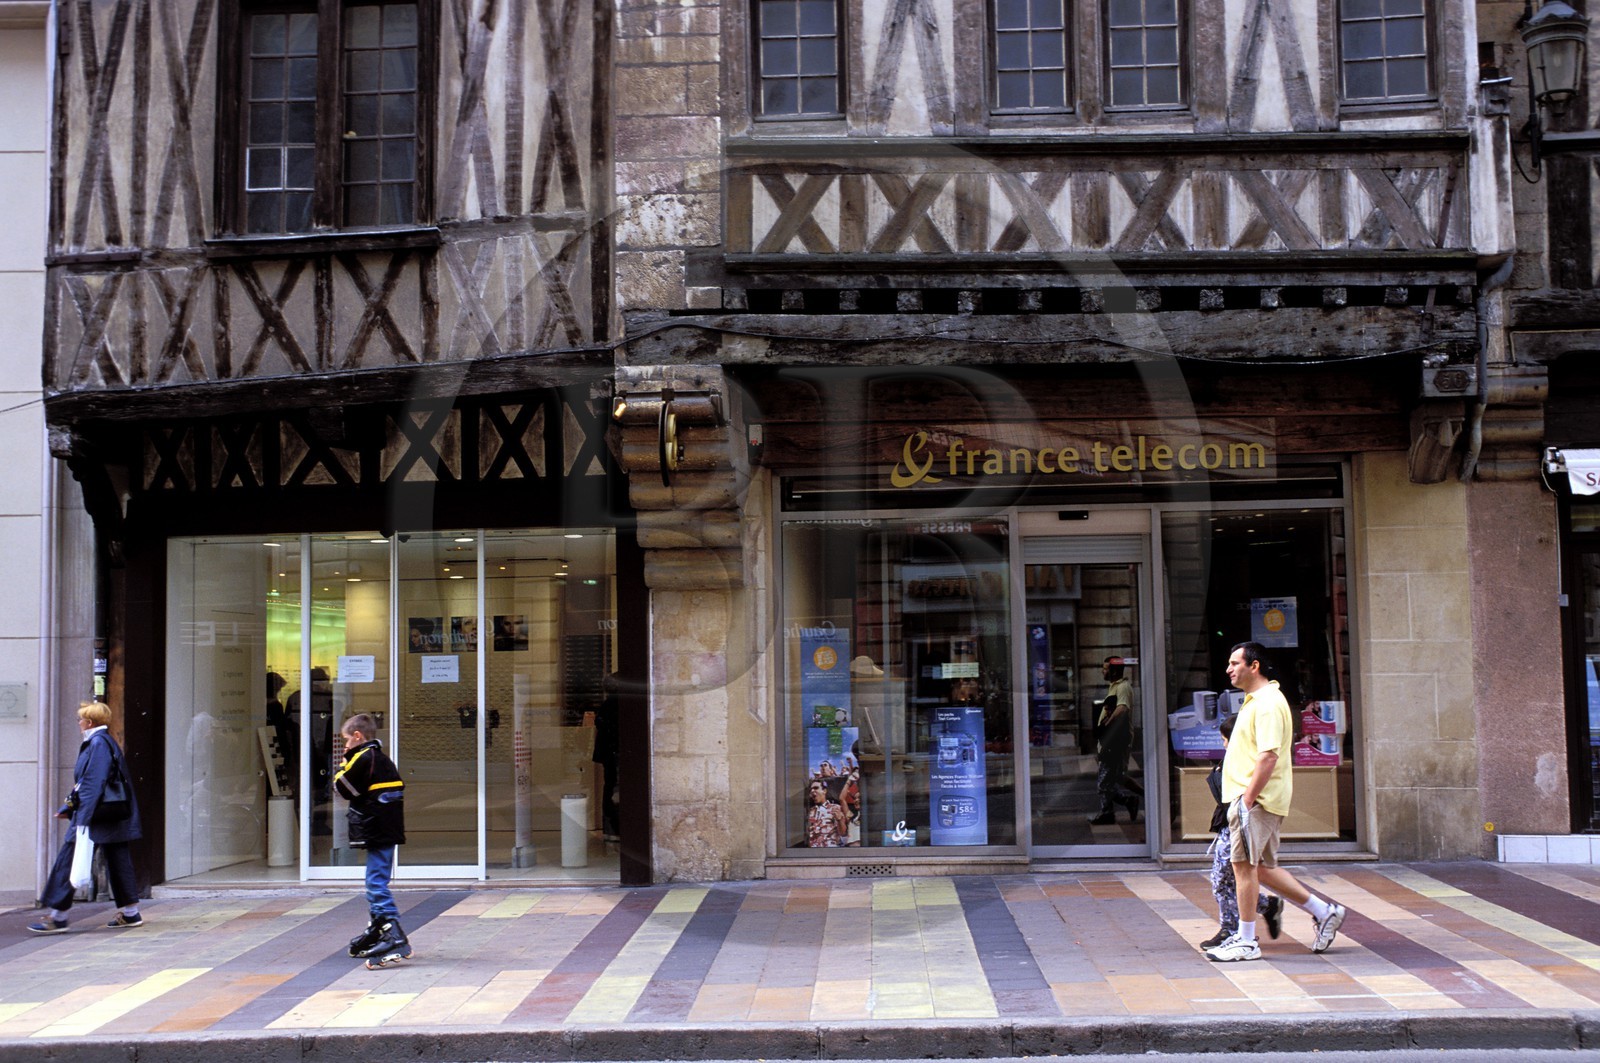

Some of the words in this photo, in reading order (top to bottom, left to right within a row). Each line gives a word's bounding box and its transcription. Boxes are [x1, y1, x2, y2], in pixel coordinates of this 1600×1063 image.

[946, 439, 1079, 476] france
[1091, 436, 1267, 473] telecom
[1586, 471, 1600, 487] S
